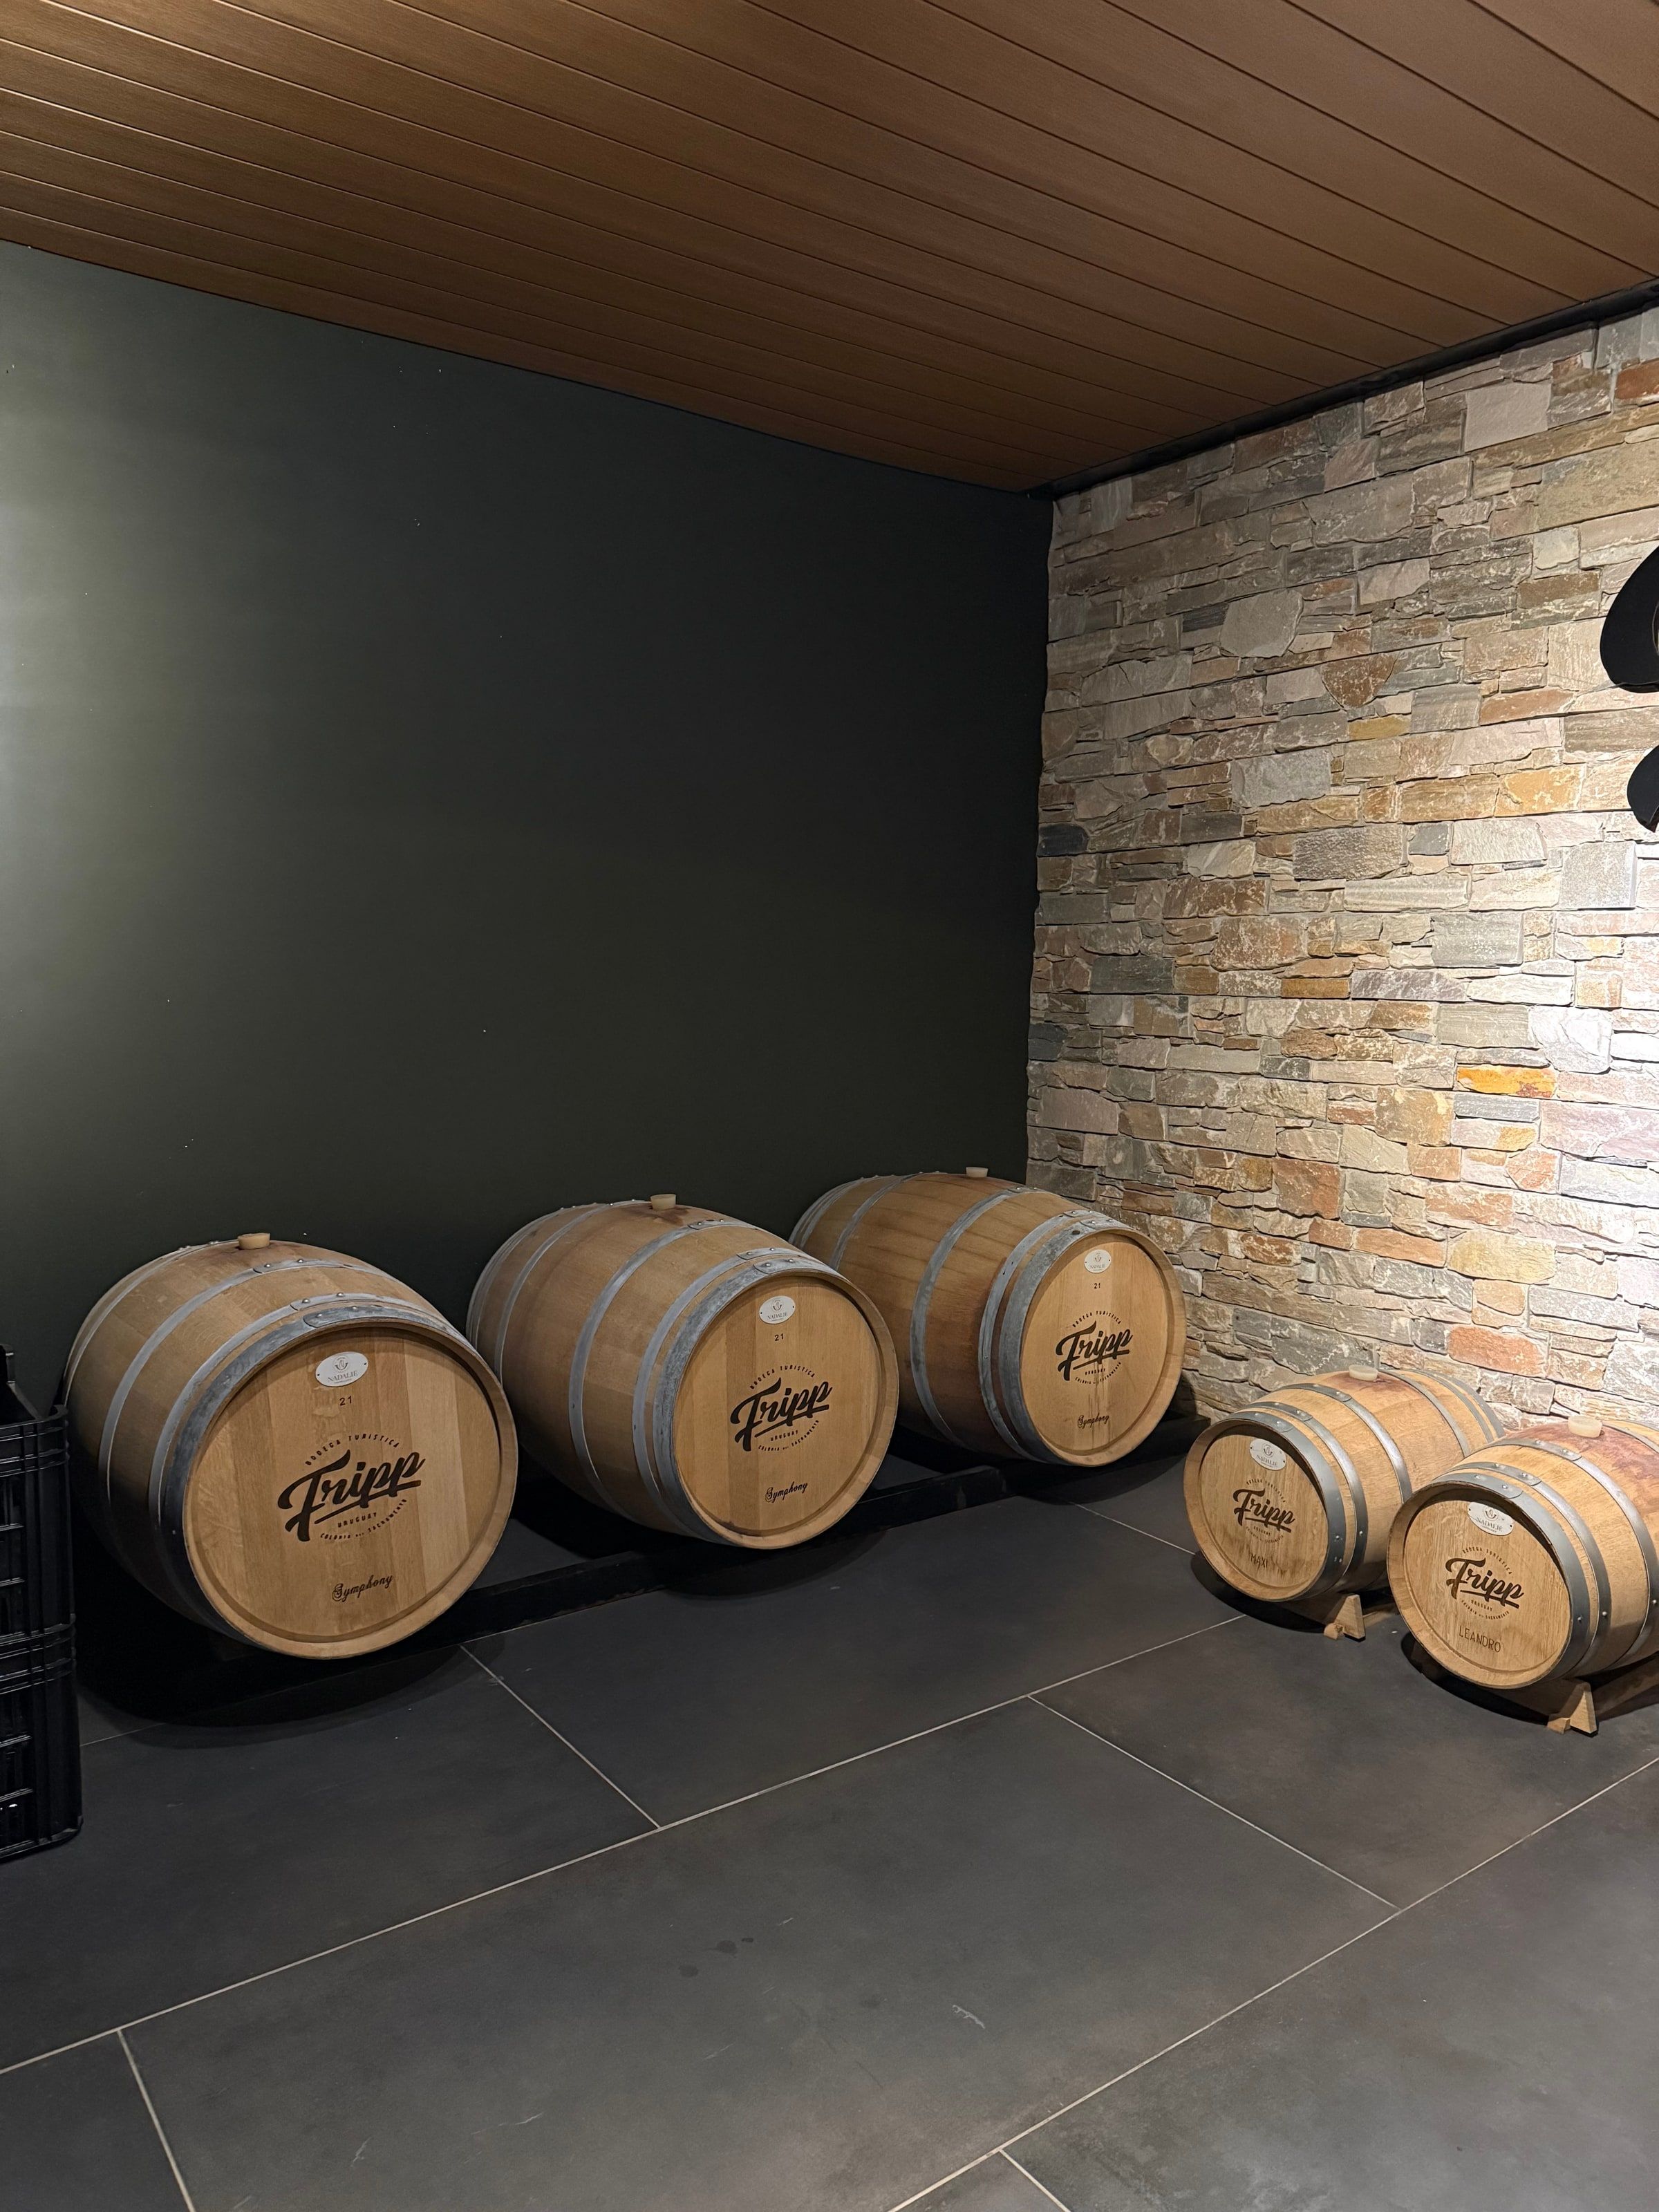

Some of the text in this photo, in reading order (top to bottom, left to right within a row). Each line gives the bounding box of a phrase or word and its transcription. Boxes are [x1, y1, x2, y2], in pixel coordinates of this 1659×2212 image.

[774, 1333, 784, 1342] 21
[1056, 1320, 1134, 1381] Tripp
[749, 1369, 775, 1389] BODEGA
[339, 1396, 352, 1406] 21
[730, 1377, 833, 1452] Tripp
[1077, 1412, 1109, 1429] Symphony
[770, 1430, 798, 1441] URUGUAY
[305, 1434, 400, 1465] BODEGA TURISTICA
[277, 1449, 426, 1542] Tripp
[765, 1481, 808, 1503] Symphony
[337, 1512, 377, 1528] URUGUAY
[1232, 1488, 1295, 1533] Tripp
[1250, 1553, 1268, 1568] MAXI
[332, 1574, 393, 1602] Symphony
[1445, 1557, 1524, 1609] Tripp
[1459, 1625, 1501, 1653] LEANDRO
